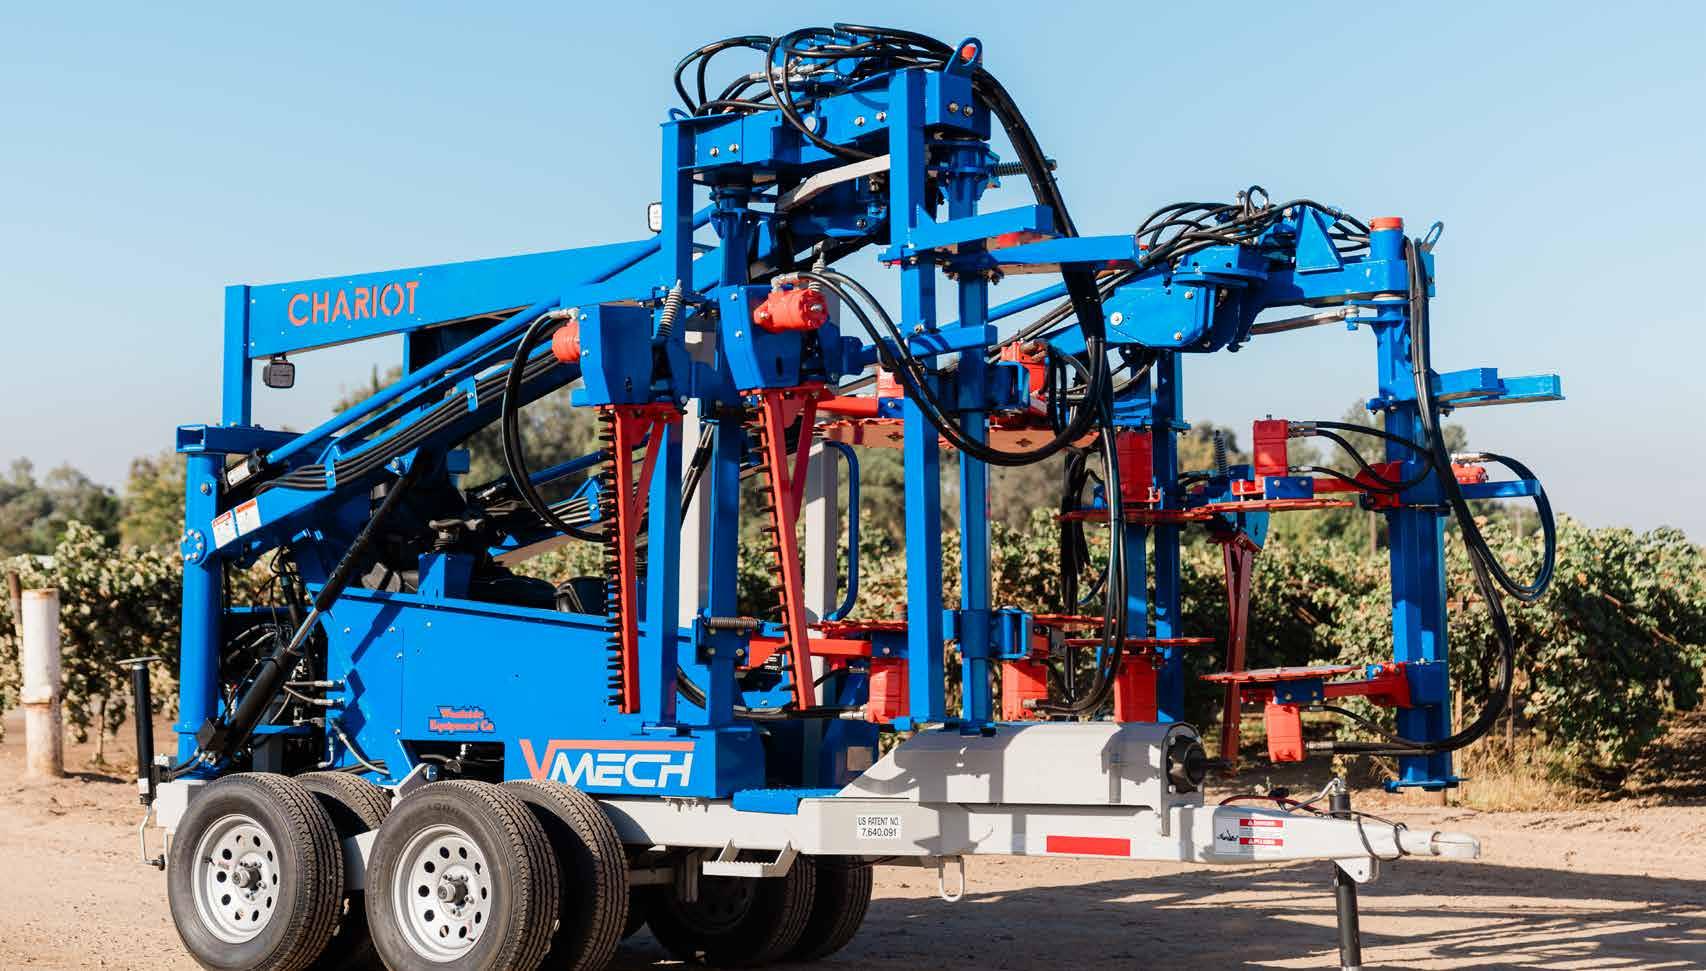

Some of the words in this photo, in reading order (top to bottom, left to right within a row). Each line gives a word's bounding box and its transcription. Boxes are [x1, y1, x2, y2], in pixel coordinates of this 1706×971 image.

[288, 281, 419, 326] CHARIOT
[857, 816, 867, 826] US
[868, 816, 889, 826] PATENT
